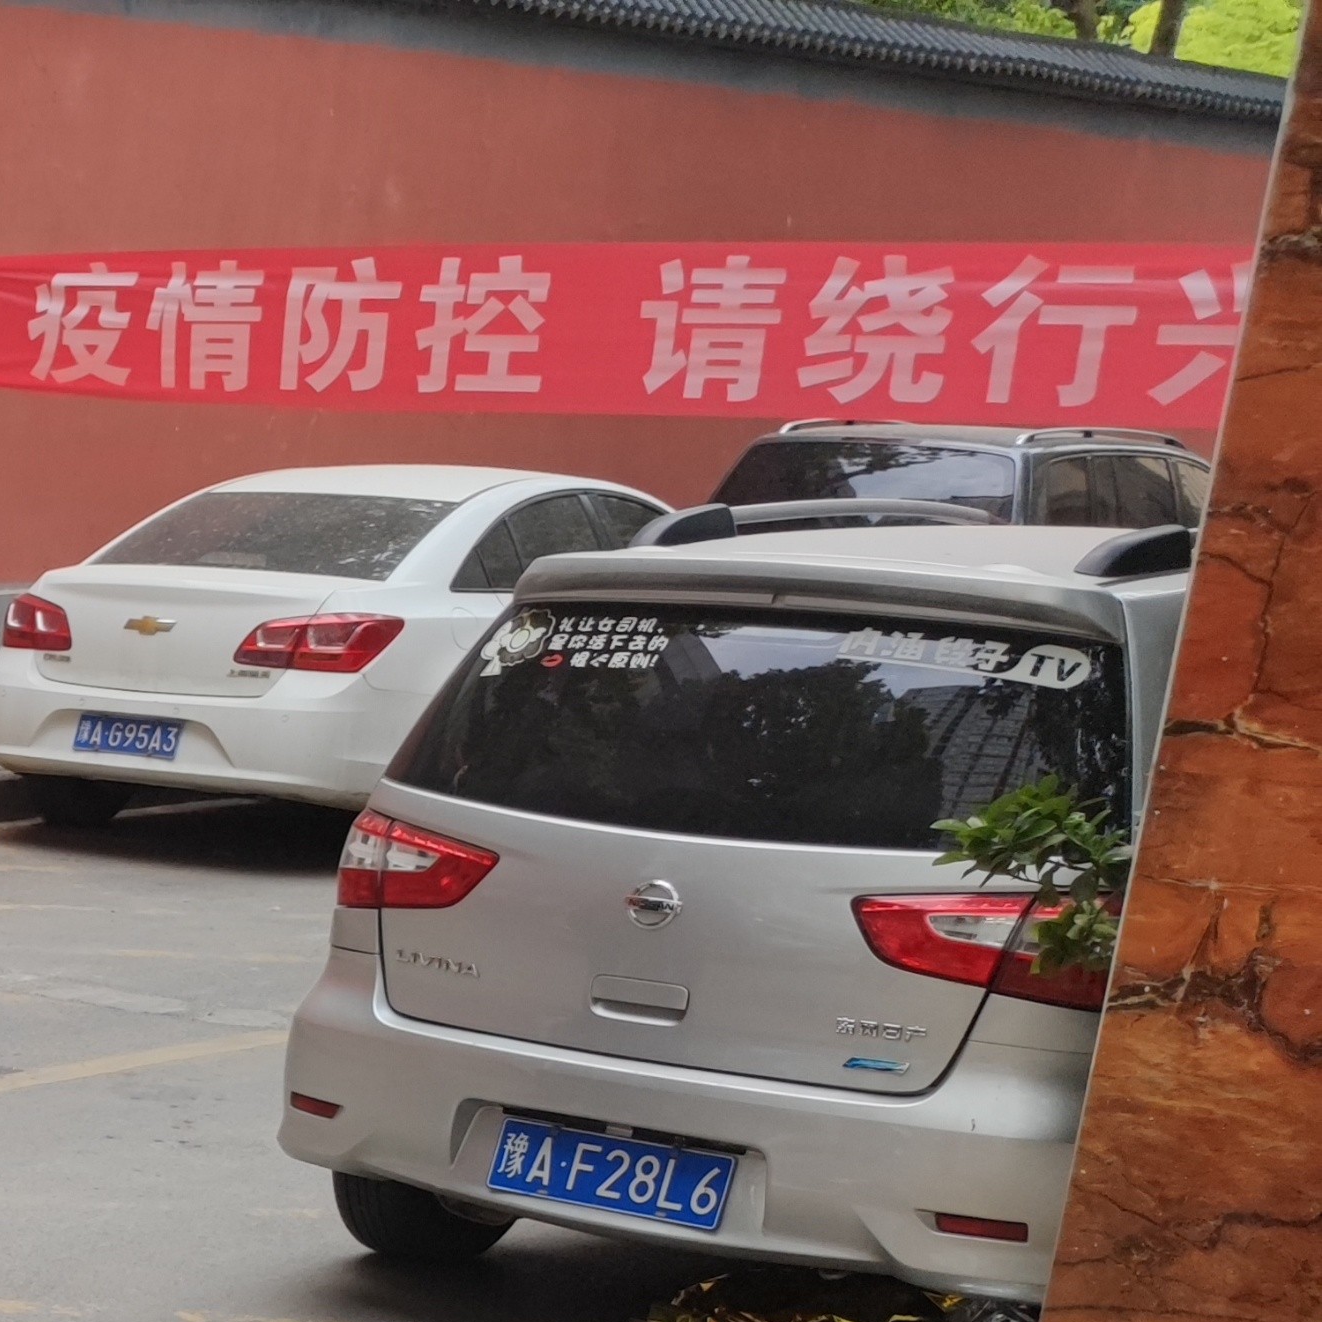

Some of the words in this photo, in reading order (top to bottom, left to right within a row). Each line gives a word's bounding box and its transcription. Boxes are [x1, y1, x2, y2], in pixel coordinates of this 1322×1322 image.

[27, 254, 552, 393] 疫情防控
[1029, 652, 1083, 683] TV
[396, 949, 481, 979] LIVINA
[835, 1016, 928, 1043] 东风日产
